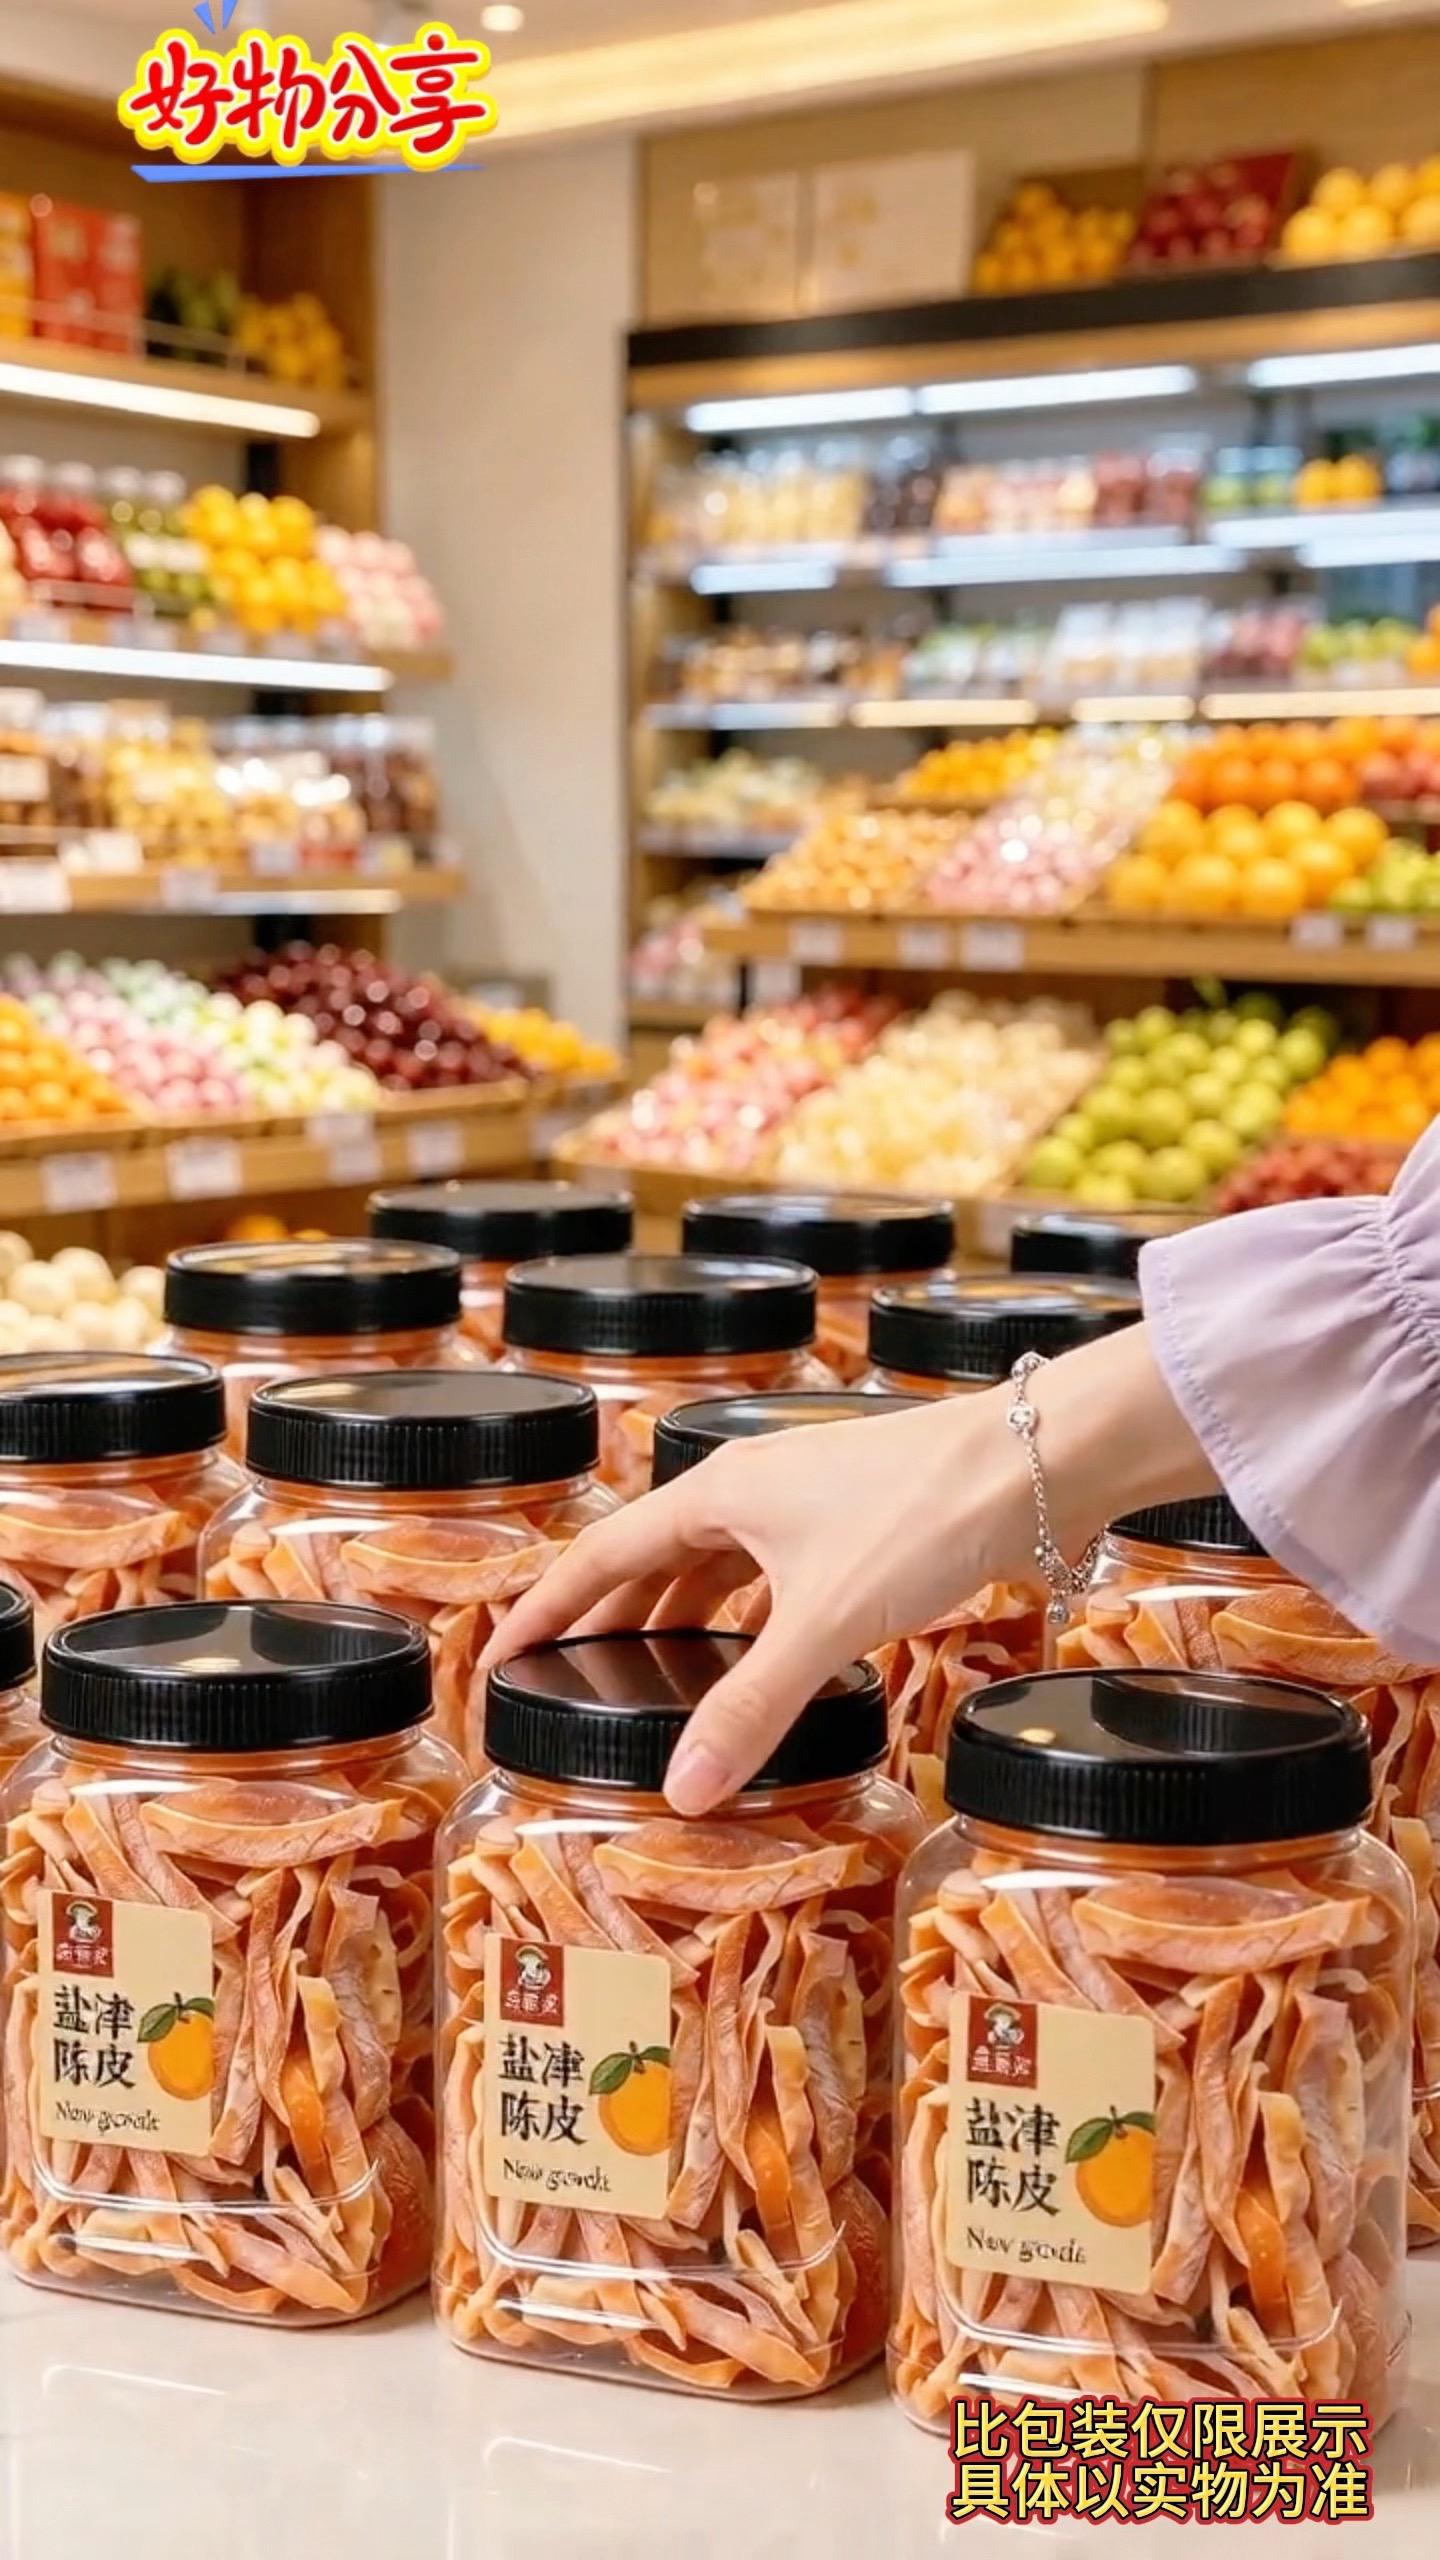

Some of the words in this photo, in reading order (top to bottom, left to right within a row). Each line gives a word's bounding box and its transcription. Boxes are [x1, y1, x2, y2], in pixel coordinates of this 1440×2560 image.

[53, 2037, 137, 2089] 陈皮
[498, 2033, 586, 2089] 盐津
[501, 2090, 588, 2146] 陈皮
[965, 2096, 1061, 2156] 盐津
[966, 2155, 1061, 2217] 陈皮
